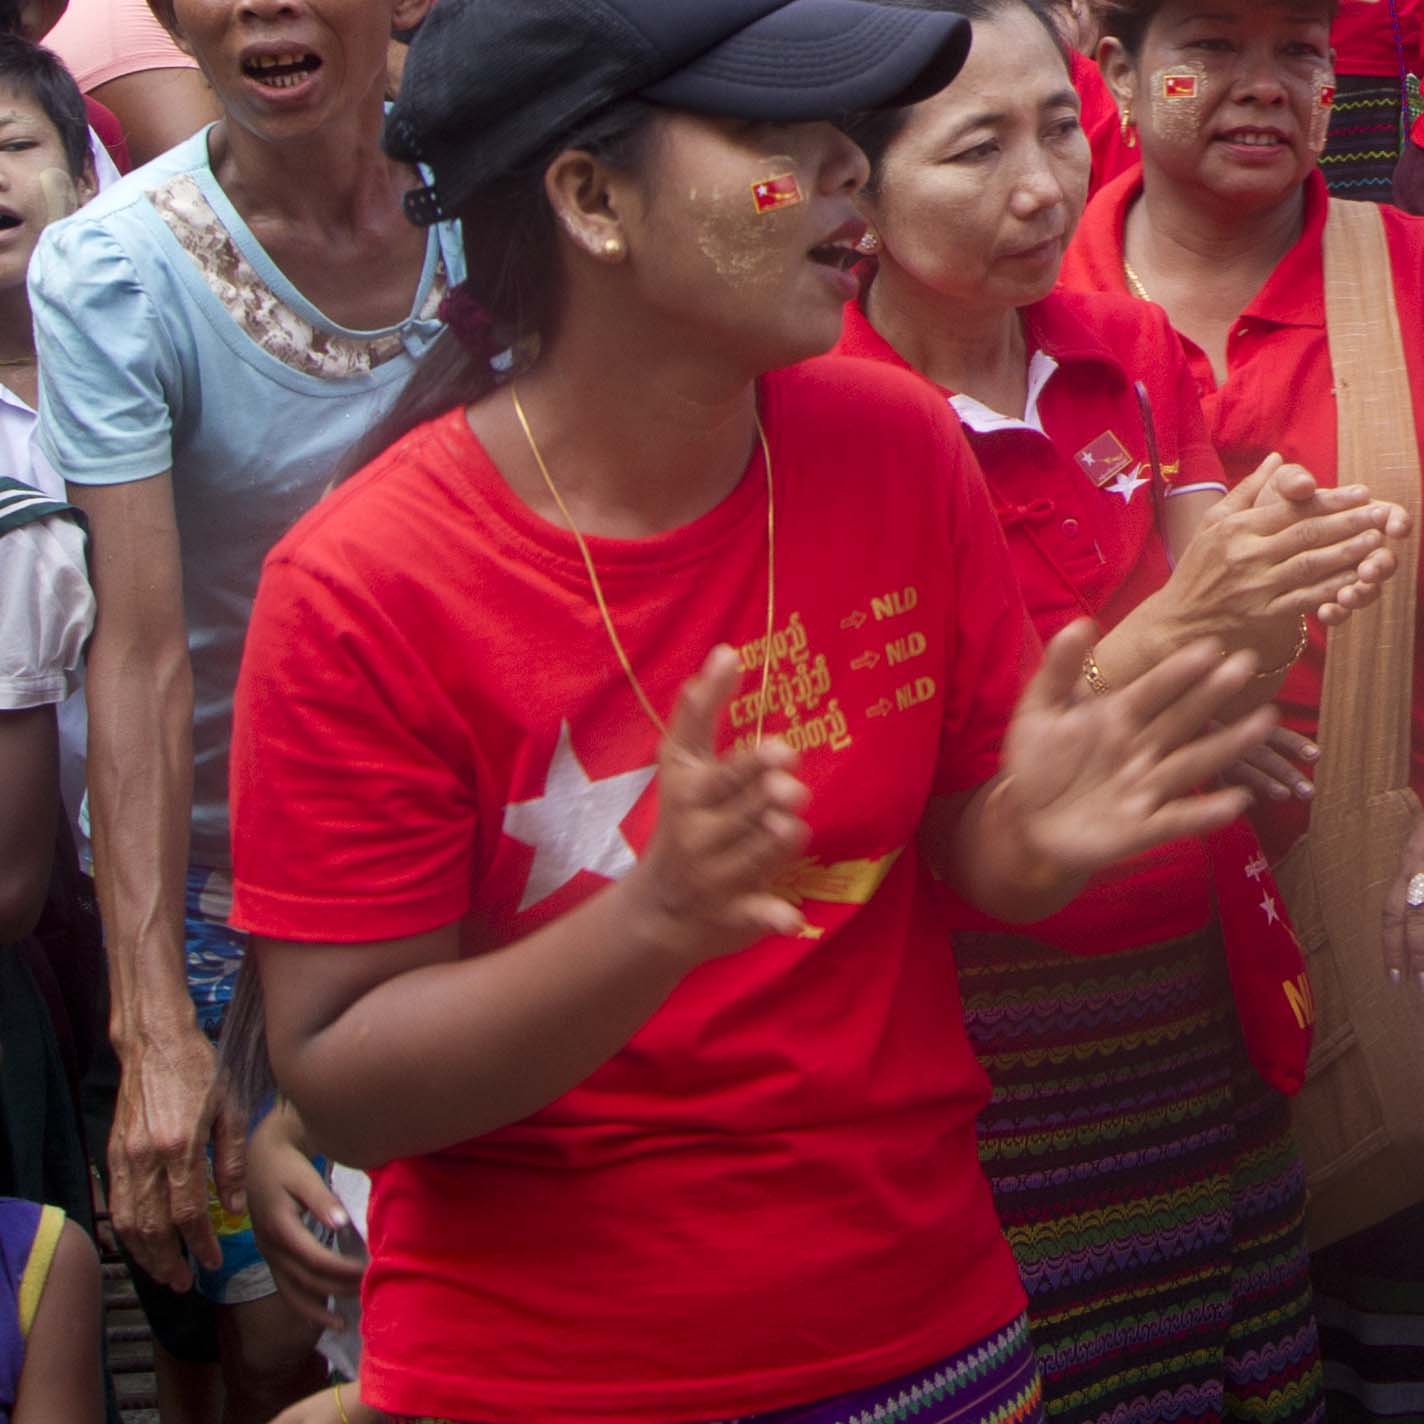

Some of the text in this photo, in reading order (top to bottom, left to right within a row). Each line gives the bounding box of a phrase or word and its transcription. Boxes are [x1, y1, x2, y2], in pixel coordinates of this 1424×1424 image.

[869, 586, 918, 622] NLD
[885, 631, 927, 667] NLD
[895, 676, 936, 712] NLD
